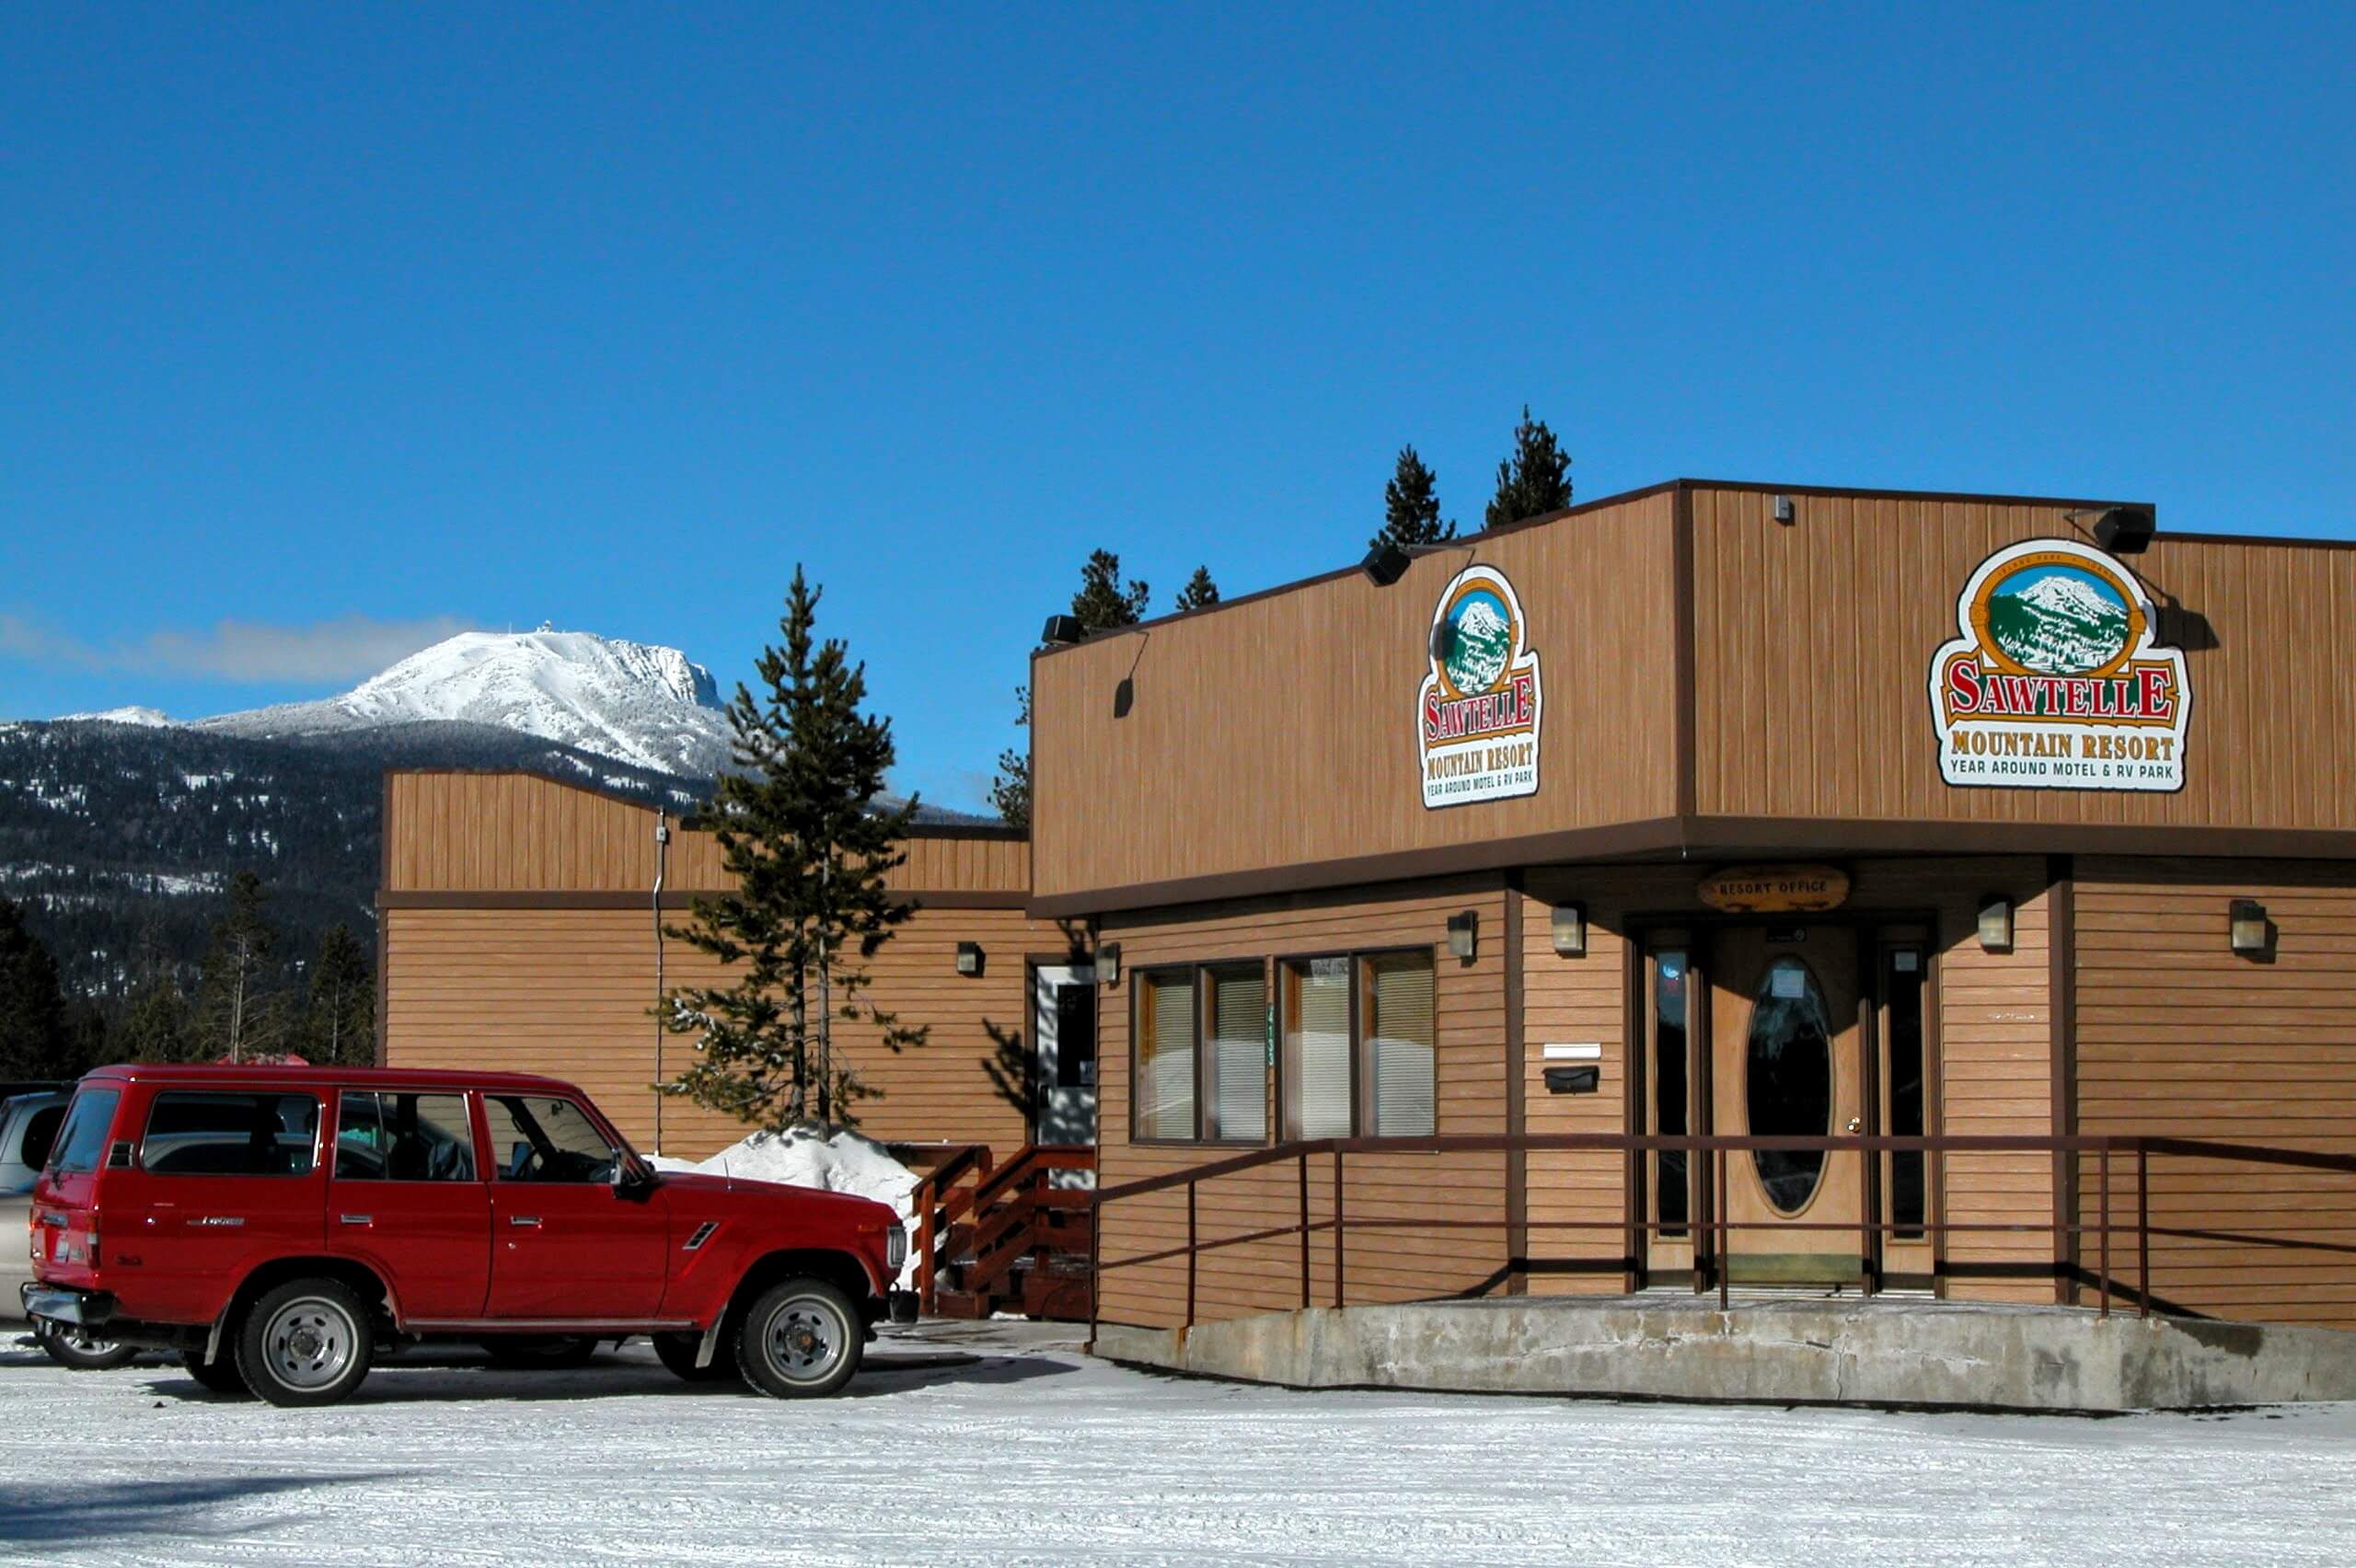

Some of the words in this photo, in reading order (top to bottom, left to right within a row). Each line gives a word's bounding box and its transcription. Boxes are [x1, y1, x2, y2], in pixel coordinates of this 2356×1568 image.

[1949, 659, 2171, 720] SAWTELLE
[1426, 676, 1531, 742] SAWTELLE
[1426, 749, 1484, 780] MOUNTAIN
[1487, 742, 1532, 771] RESORT
[1950, 730, 2073, 757] MOUNTAIN
[2082, 734, 2175, 761] RESORT
[1426, 780, 1443, 797] YEAR
[1445, 778, 1471, 793] AROUND
[1473, 774, 1495, 790] MOTEL
[1515, 770, 1532, 783] PARK
[1951, 759, 1985, 773] YEAR
[1992, 760, 2047, 775] AROUND
[2053, 763, 2096, 777] MOTEL
[2102, 764, 2110, 777] &
[2117, 765, 2133, 778] RV
[2139, 765, 2173, 779] PARK
[1720, 882, 1772, 895] RESORT
[1778, 881, 1827, 894] OFFICE
